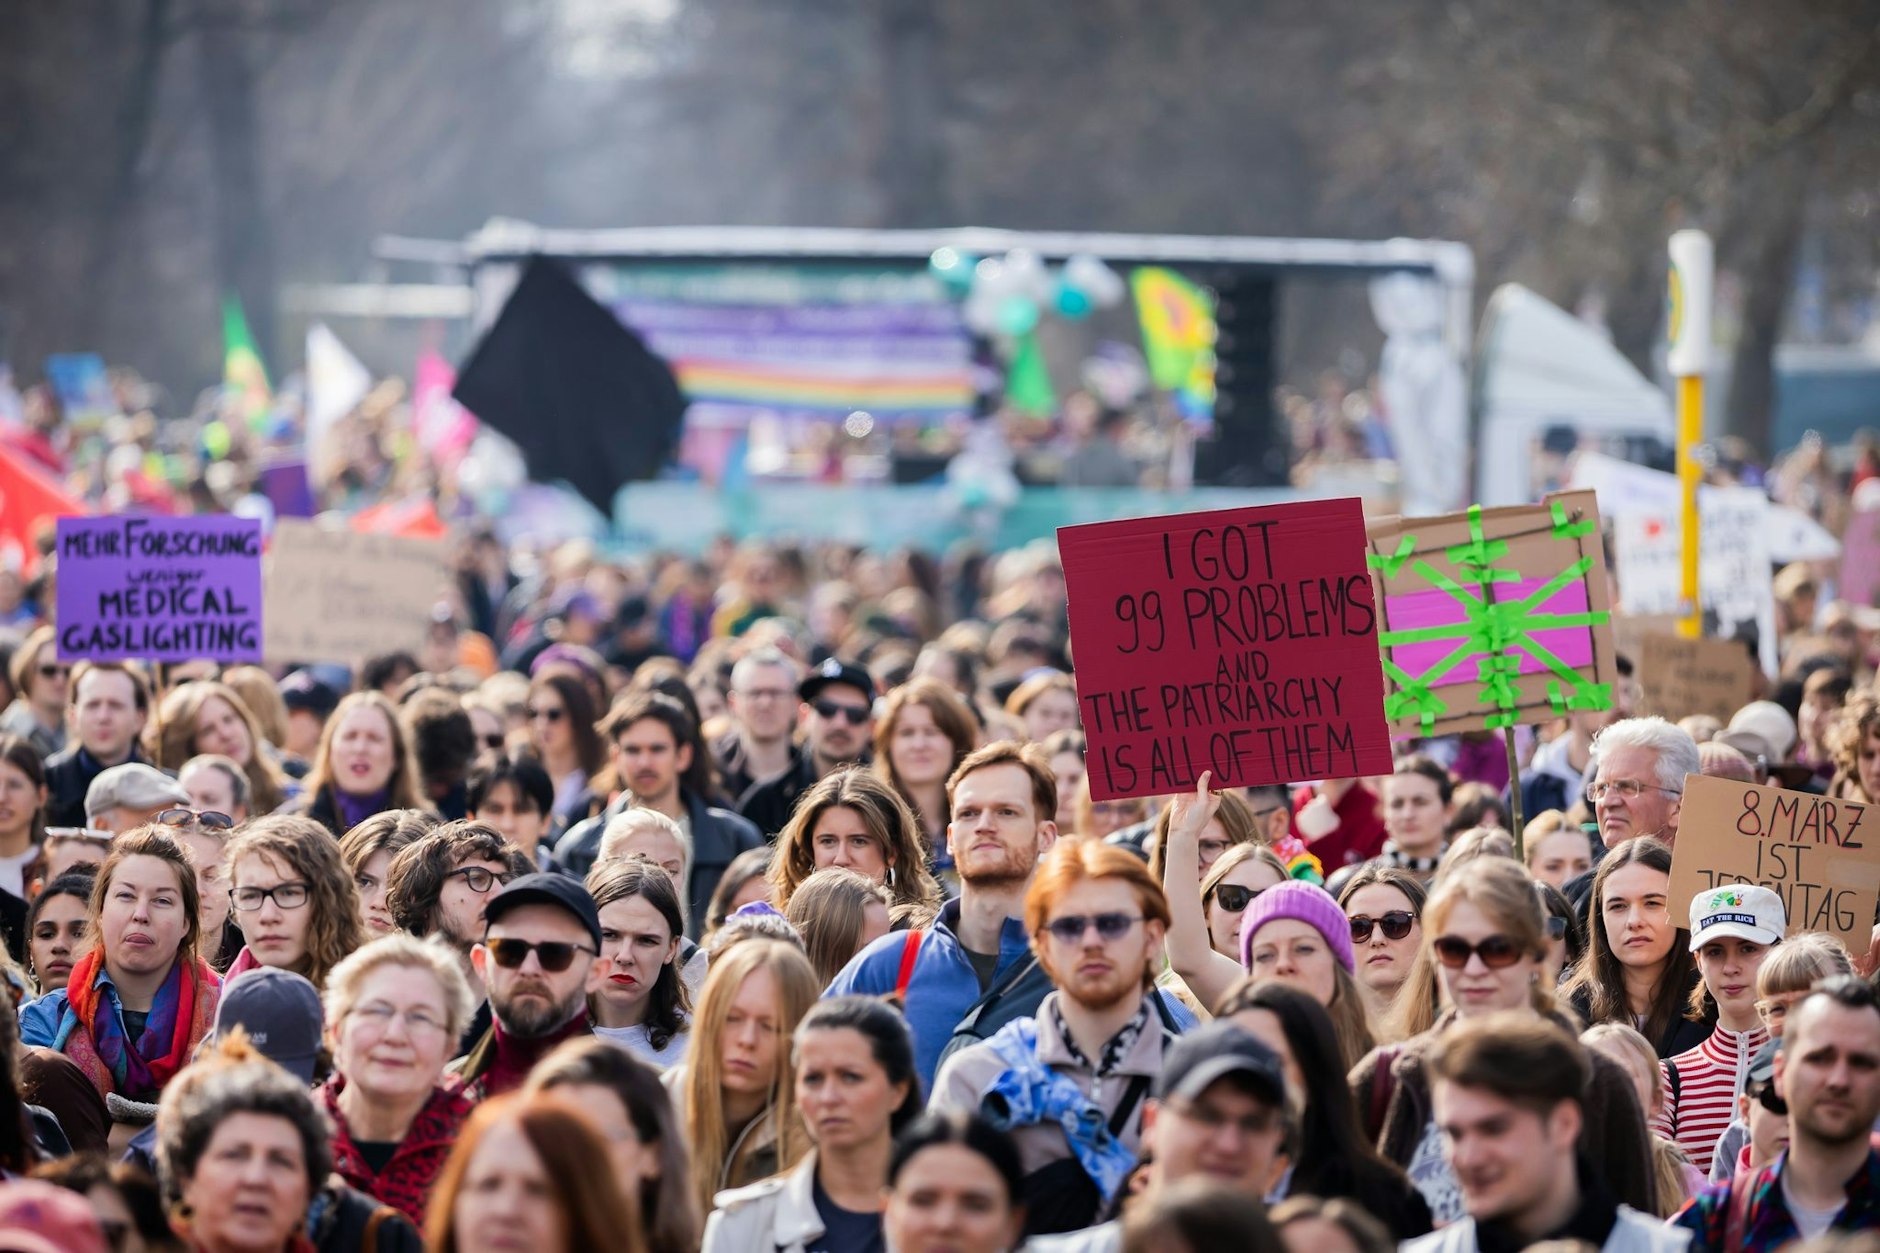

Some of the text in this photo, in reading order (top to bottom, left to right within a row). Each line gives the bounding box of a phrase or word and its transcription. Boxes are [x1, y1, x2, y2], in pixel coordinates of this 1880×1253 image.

[64, 529, 121, 560] MEHR
[124, 518, 258, 558] FORSCHUNG
[1162, 520, 1279, 581] I GOT
[99, 586, 248, 618] MEDICAL
[1115, 574, 1375, 653] 99 PROBLEMS
[62, 621, 257, 655] GASLIGHTING
[1216, 650, 1269, 683] AND
[1084, 676, 1342, 733] THE PATRIARCHY
[1101, 721, 1358, 793] IS ALL OF THEM
[1756, 840, 1812, 882] IST
[1735, 914, 1754, 923] RICH
